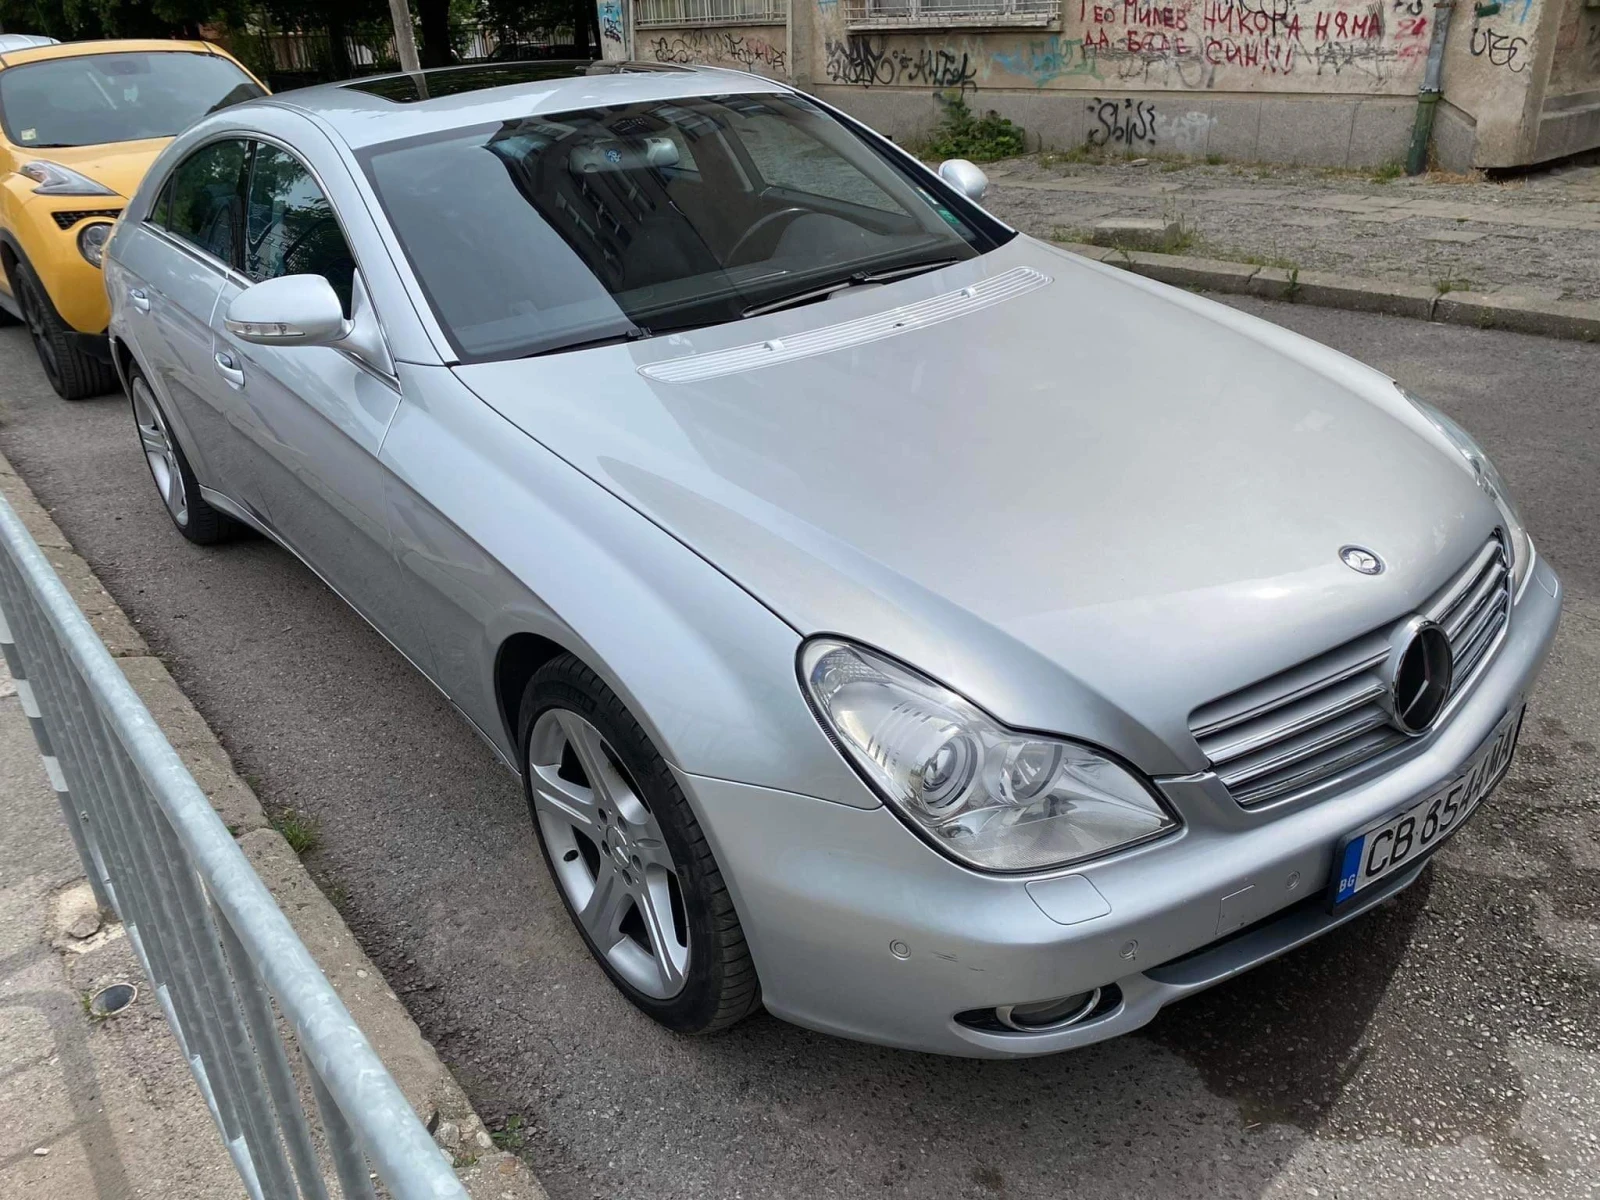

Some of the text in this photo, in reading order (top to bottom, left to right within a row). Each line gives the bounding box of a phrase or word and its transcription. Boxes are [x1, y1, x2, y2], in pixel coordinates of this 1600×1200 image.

[1315, 11, 1381, 39] НЯМА
[1365, 816, 1415, 878] CB
[1339, 874, 1356, 893] BG
